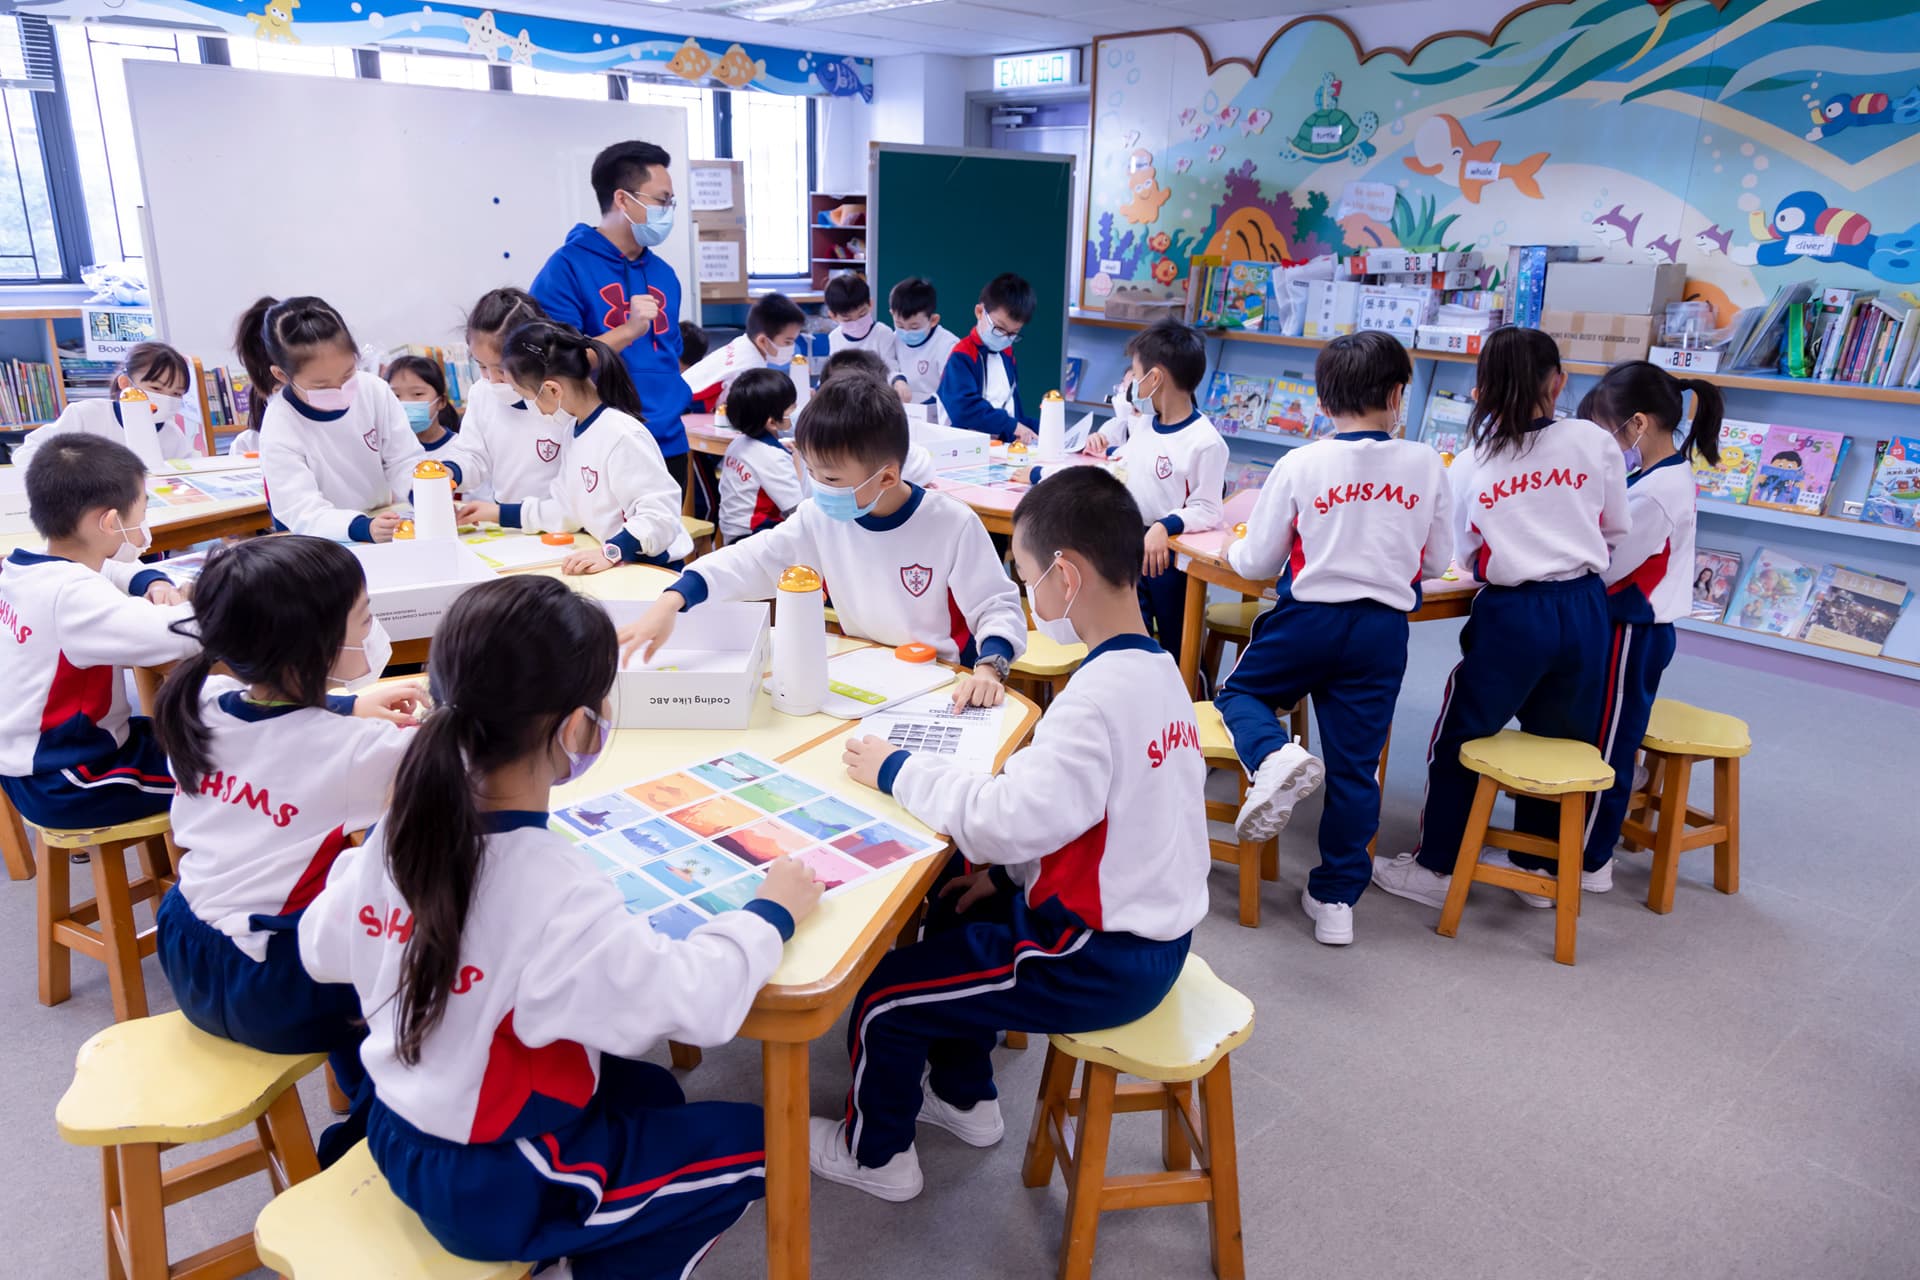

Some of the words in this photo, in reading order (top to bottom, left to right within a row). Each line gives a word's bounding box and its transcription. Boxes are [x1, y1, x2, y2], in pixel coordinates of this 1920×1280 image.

[1000, 59, 1032, 86] EXIT
[1038, 56, 1064, 82] 出口
[1796, 240, 1825, 250] diver
[1479, 468, 1587, 510] SKHSMS
[1314, 483, 1420, 514] SKHSMS
[650, 696, 669, 704] ABC
[672, 696, 692, 705] Like
[694, 695, 730, 705] Coding
